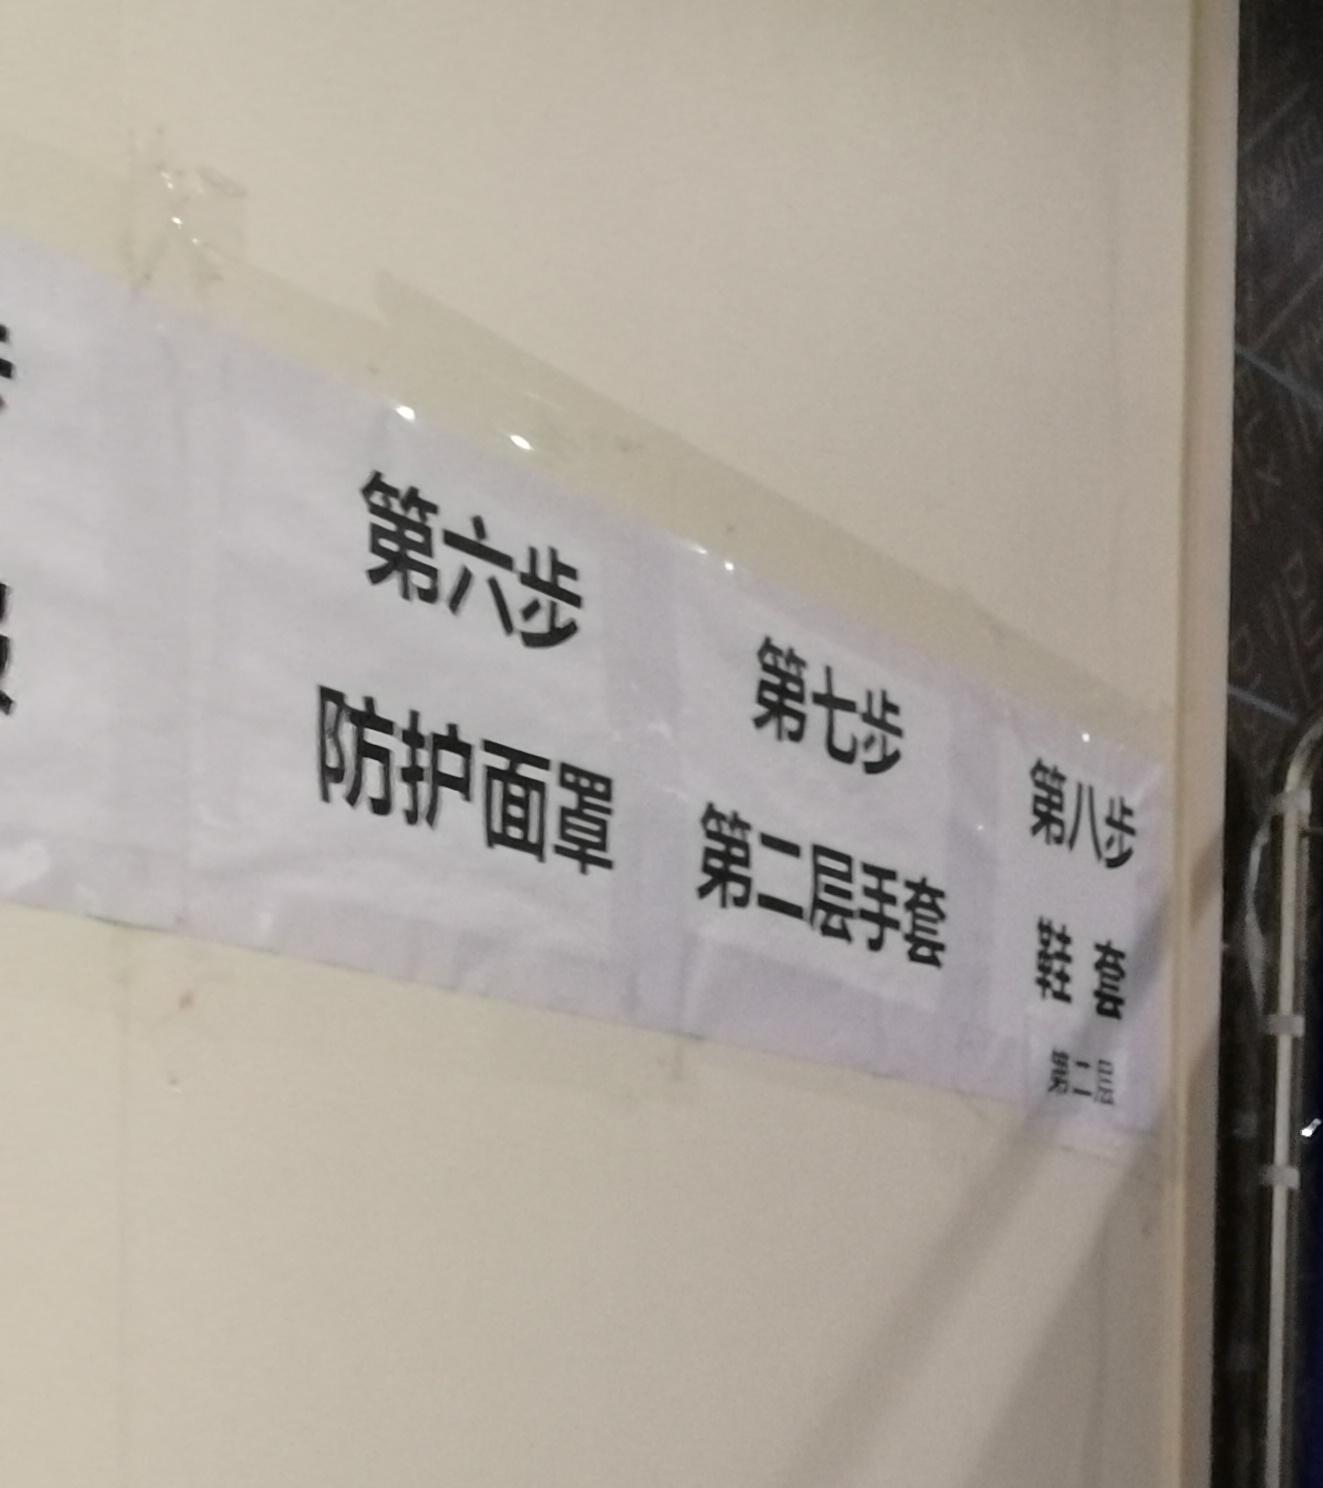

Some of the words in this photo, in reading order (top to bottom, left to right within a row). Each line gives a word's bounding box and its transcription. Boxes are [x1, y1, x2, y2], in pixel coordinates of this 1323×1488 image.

[360, 470, 583, 649] 第六步
[317, 683, 614, 874] 防护面罩
[753, 636, 904, 775] 第七步
[696, 803, 947, 968] 第二层手套
[1029, 758, 1136, 869] 第八步
